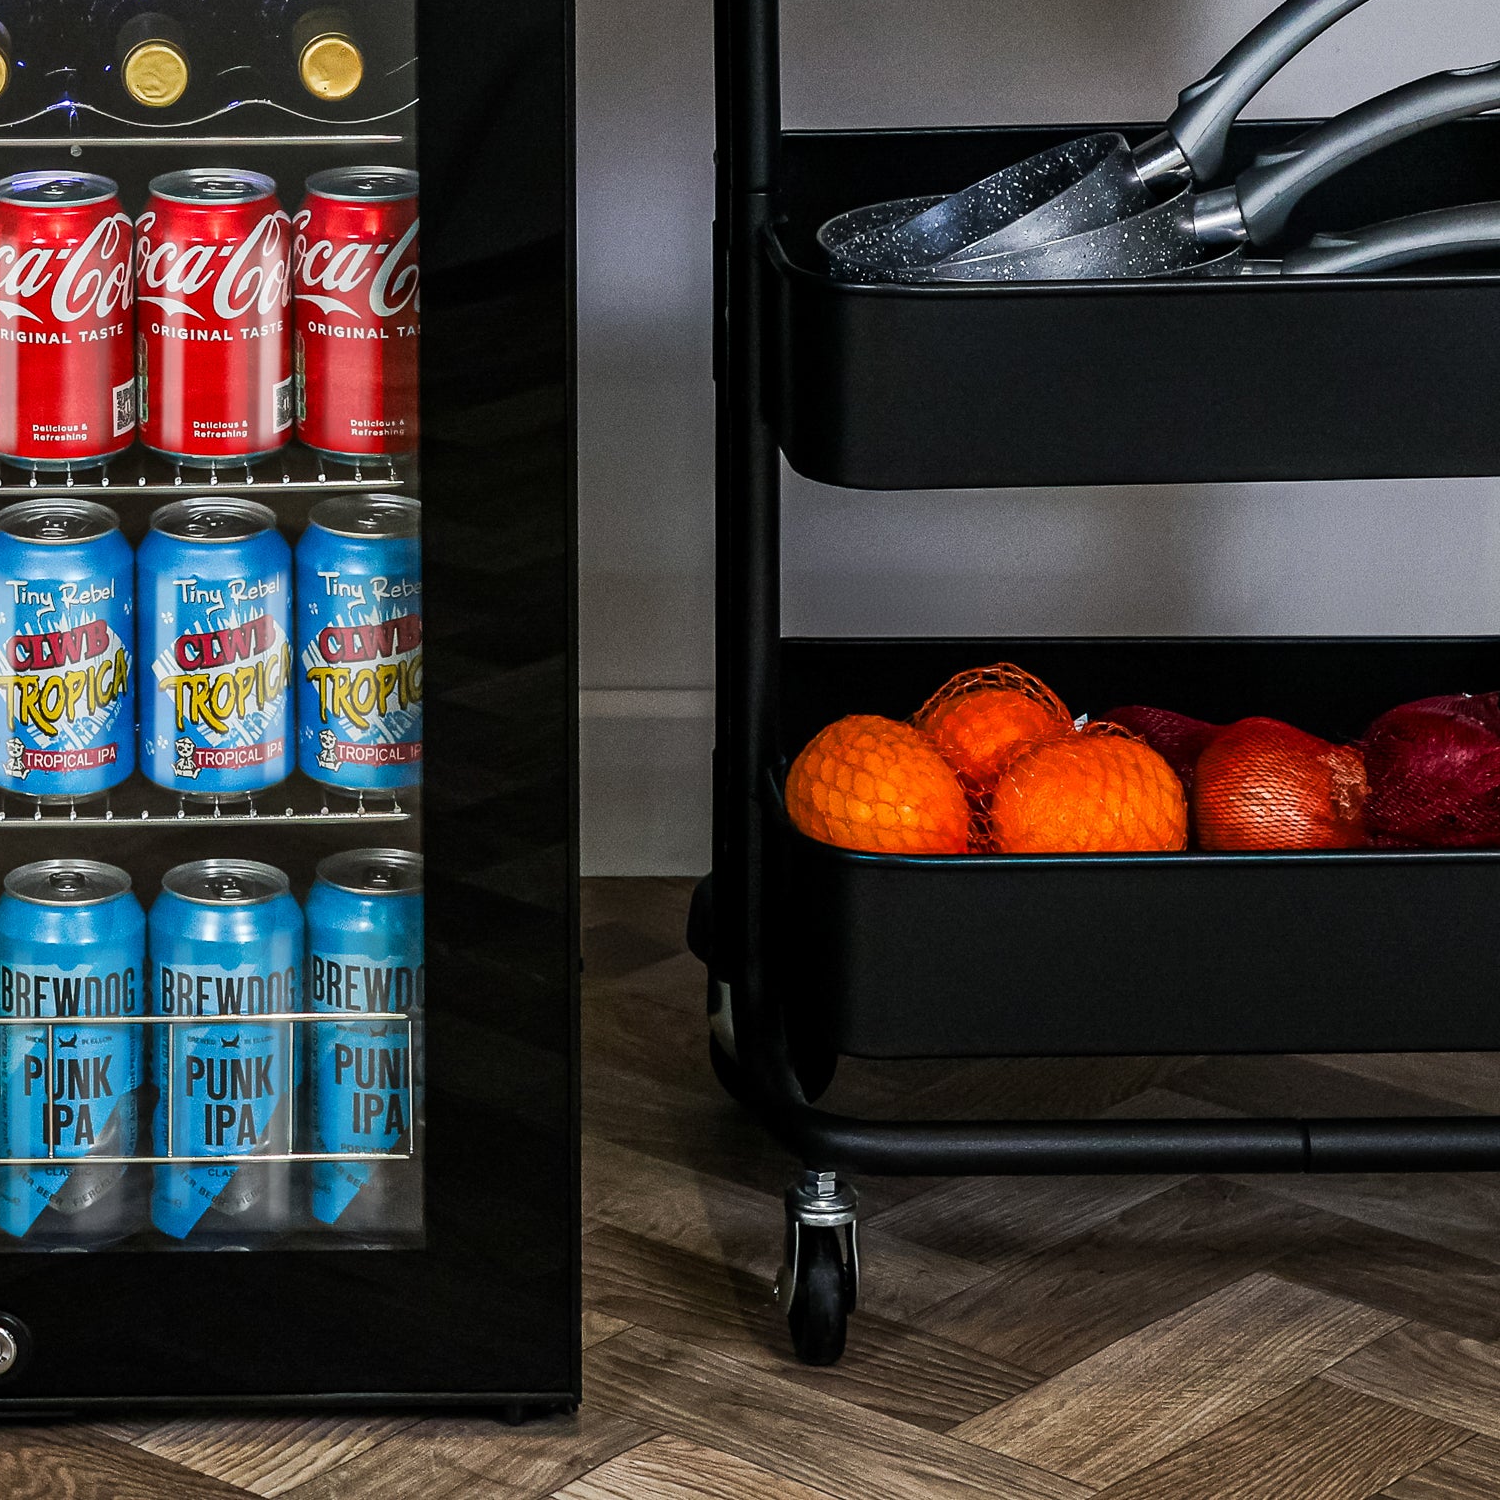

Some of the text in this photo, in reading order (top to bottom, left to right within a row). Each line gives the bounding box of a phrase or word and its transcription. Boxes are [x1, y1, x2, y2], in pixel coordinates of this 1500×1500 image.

[79, 323, 124, 342] TASTE
[151, 320, 284, 341] ORIGINAL TASTE
[308, 321, 389, 339] ORIGINAL
[32, 423, 88, 432] Delicious &
[33, 432, 88, 441] Refreshing
[193, 420, 248, 429] Delicious &
[193, 430, 248, 438] Refreshing
[6, 578, 115, 620] Tiny Rebel
[173, 572, 280, 617] Tiny Rebel
[5, 619, 110, 672] CLWB
[175, 614, 277, 671] CLWB
[158, 641, 292, 734] TROPICA
[26, 748, 116, 768] TROPICAL IPA
[196, 742, 283, 765] TROPICAL IPA
[338, 744, 405, 761] TROPICAL
[2, 965, 135, 1017] BREWDOG
[162, 966, 296, 1015] BREWDOG
[24, 1054, 112, 1100] PUNK
[185, 1054, 275, 1101] PUNK
[42, 1103, 95, 1146] IPA
[204, 1103, 257, 1146] IPA
[353, 1092, 405, 1135] IPA
